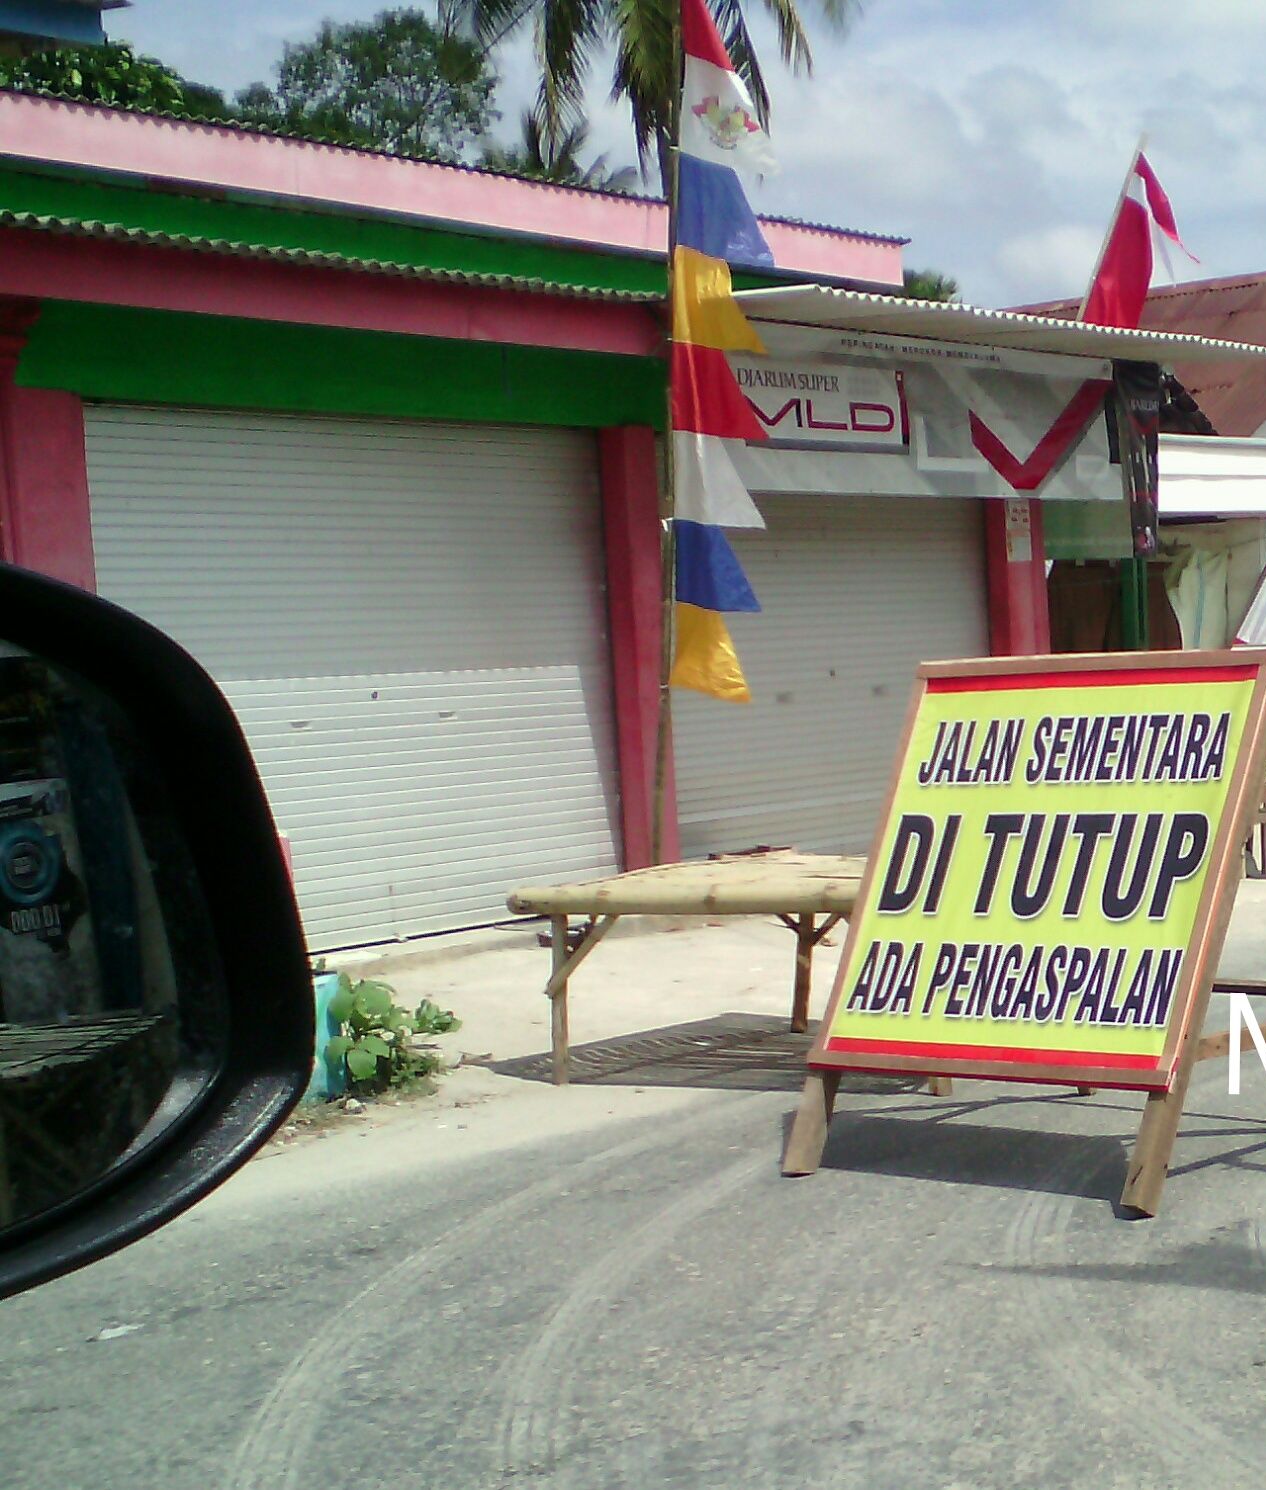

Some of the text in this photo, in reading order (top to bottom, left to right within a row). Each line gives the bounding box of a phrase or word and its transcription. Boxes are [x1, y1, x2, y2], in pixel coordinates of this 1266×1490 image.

[737, 367, 796, 389] DJARUM
[797, 373, 840, 392] SUPER
[918, 712, 1230, 785] JALAN SEMENTARA
[877, 812, 1209, 921] DI TUTUP
[846, 940, 1184, 1028] ADA PENGASPALAN
